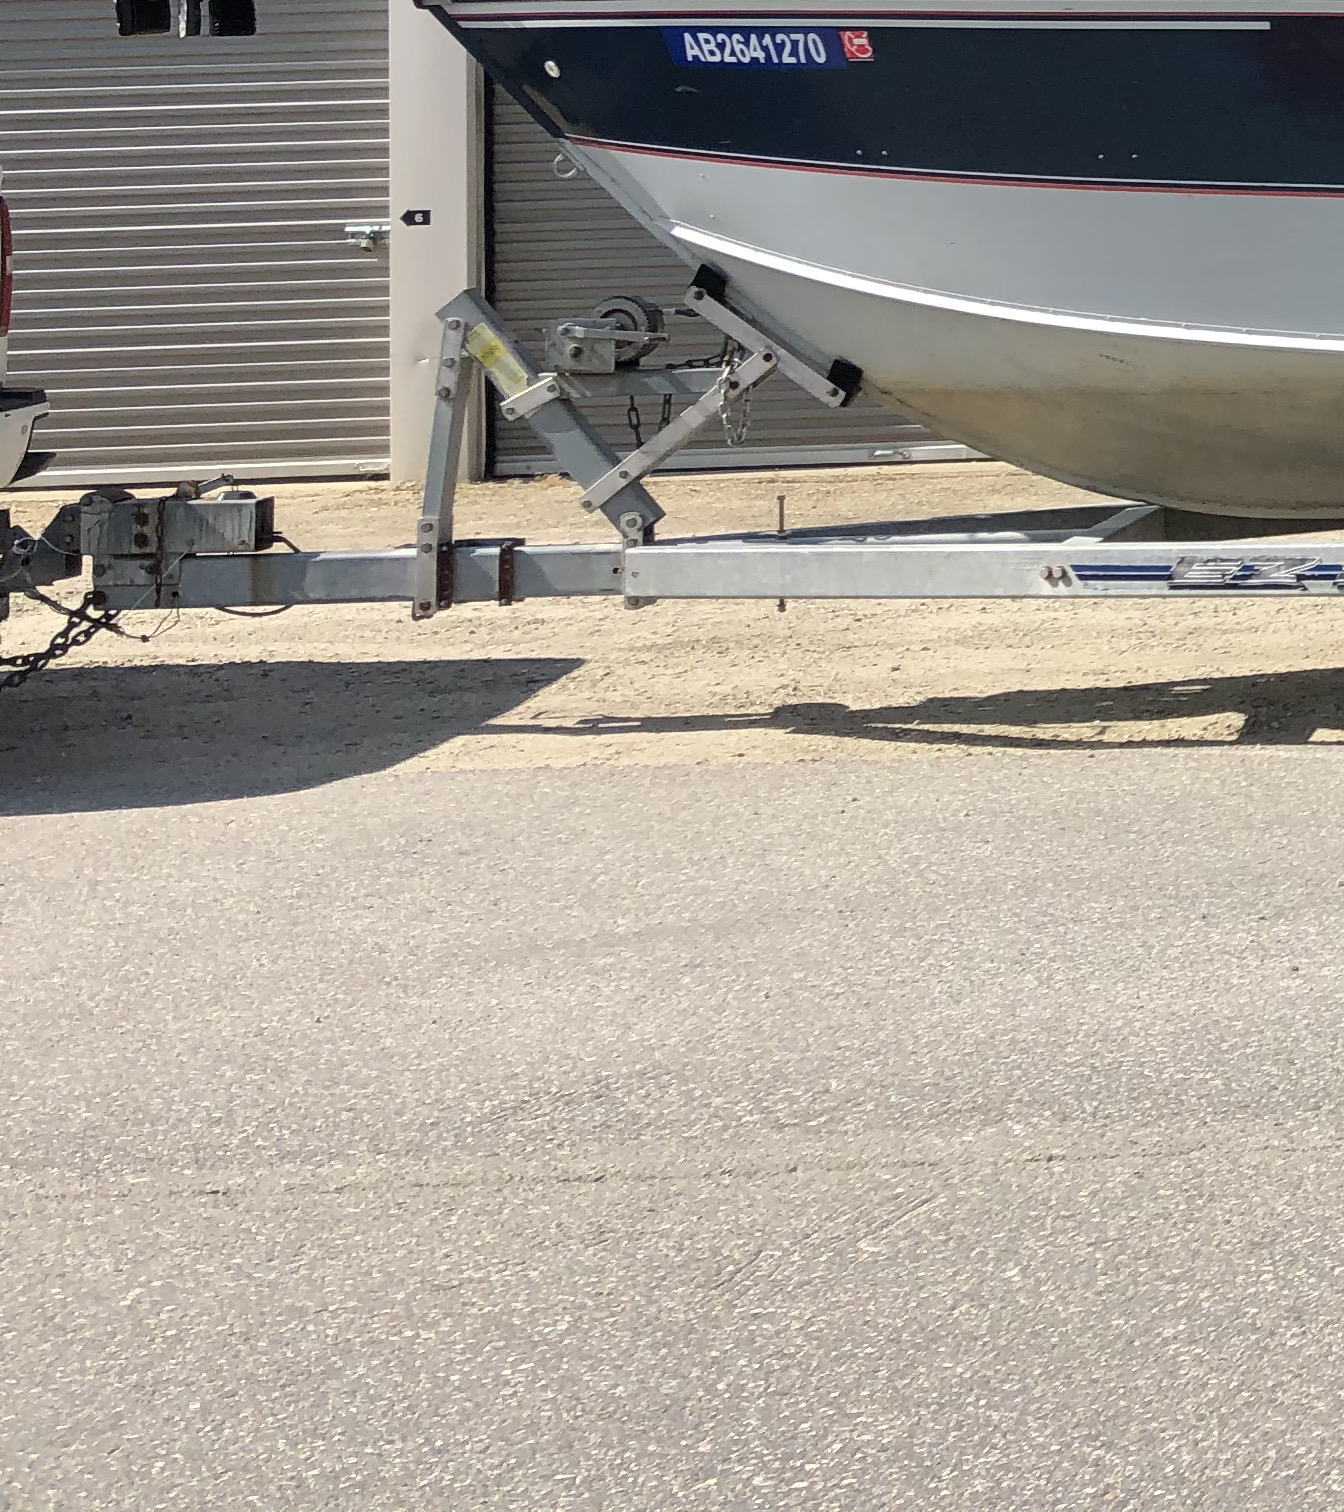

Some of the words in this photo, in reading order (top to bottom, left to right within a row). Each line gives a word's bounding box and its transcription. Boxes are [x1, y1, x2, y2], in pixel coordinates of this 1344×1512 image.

[683, 32, 827, 64] AB2641270
[414, 213, 424, 223] 6
[1168, 556, 1320, 589] EZ
